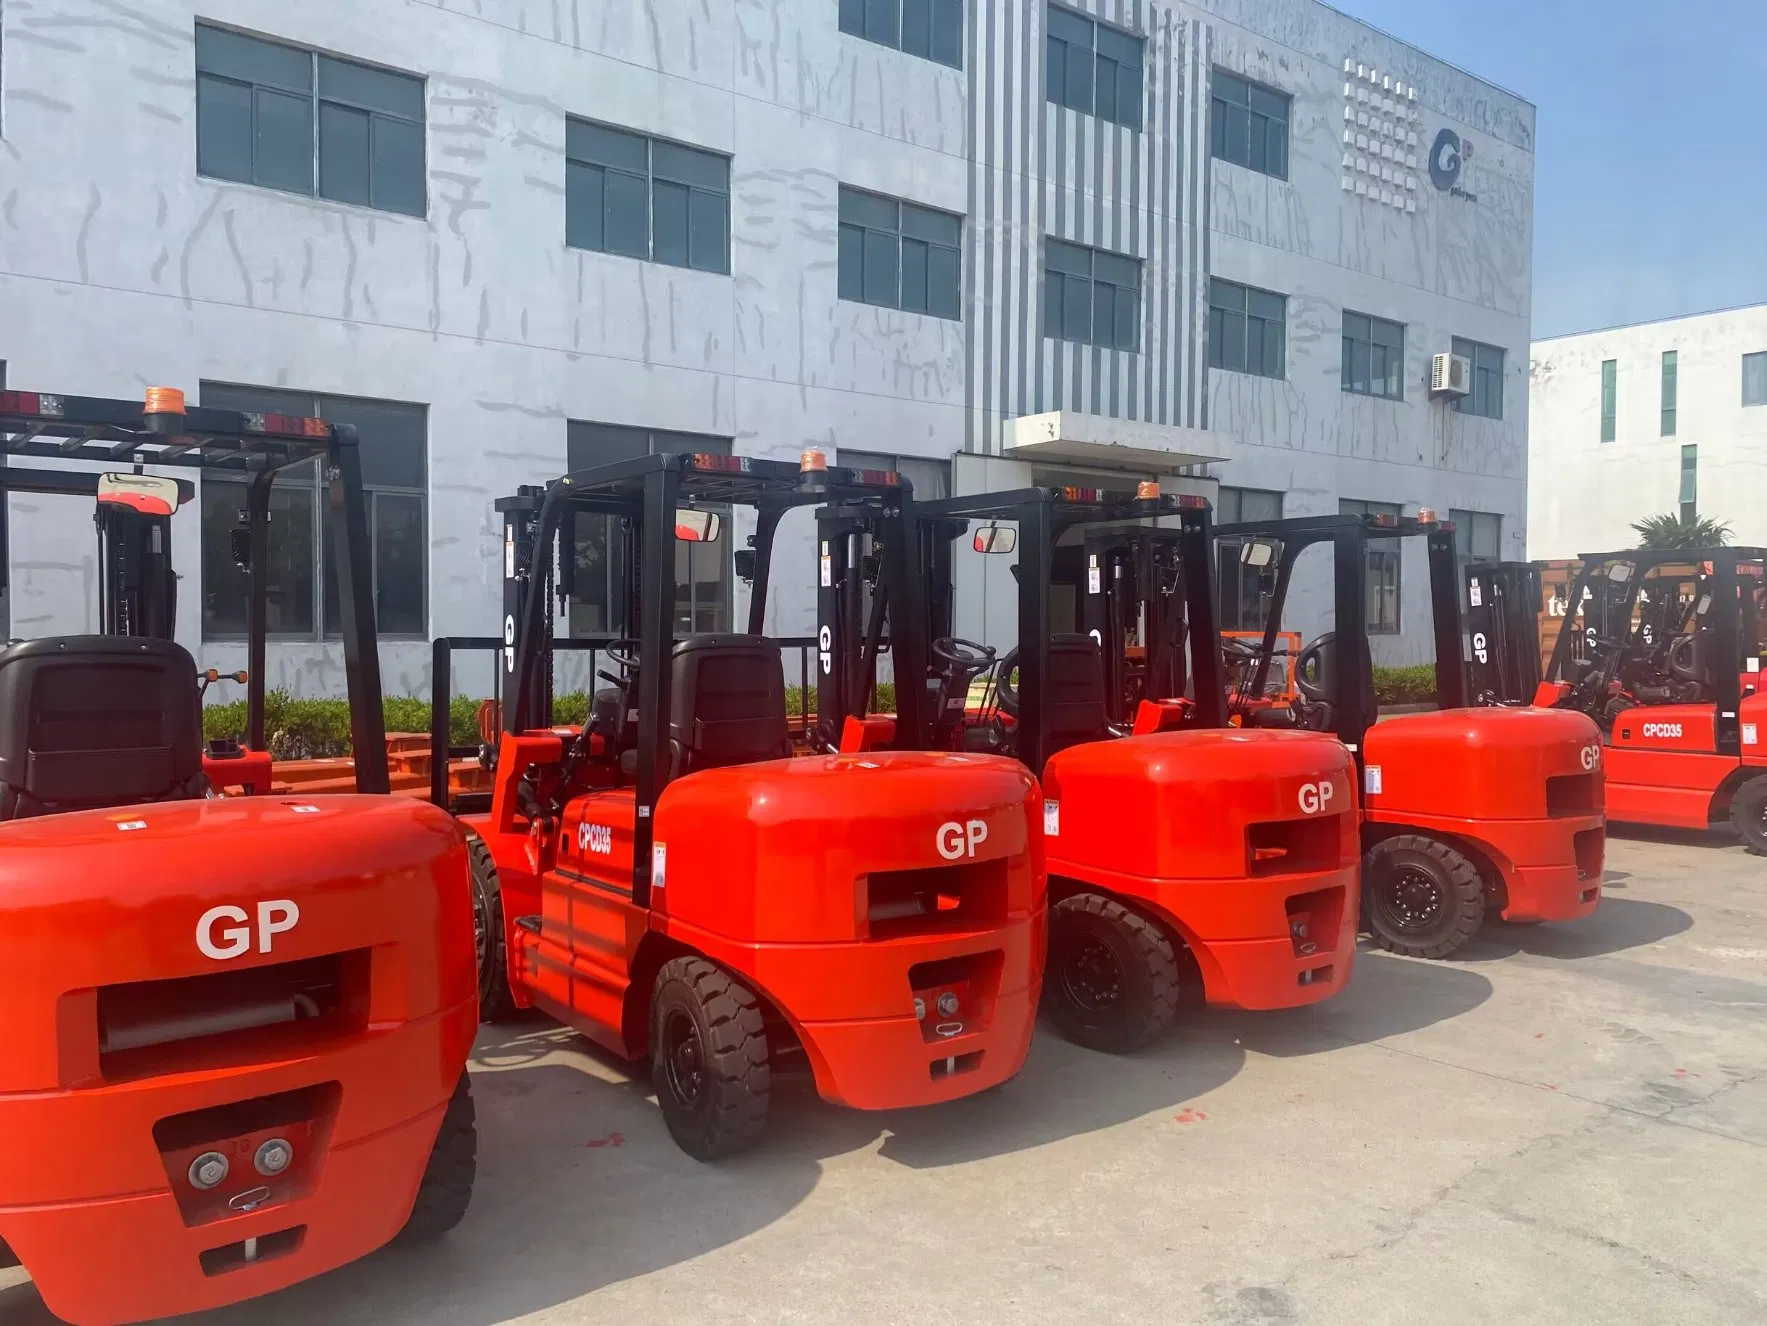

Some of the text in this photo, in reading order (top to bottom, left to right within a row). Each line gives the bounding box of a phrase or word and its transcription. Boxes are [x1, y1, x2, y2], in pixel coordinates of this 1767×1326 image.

[505, 614, 515, 673] GP
[820, 625, 831, 675] GP
[1473, 632, 1488, 664] GP
[1643, 723, 1682, 738] CPCD35
[1581, 745, 1600, 770] GP
[1298, 781, 1334, 814] GP
[578, 821, 612, 855] CPCD35
[936, 819, 988, 860] GP
[195, 899, 300, 960] GP
